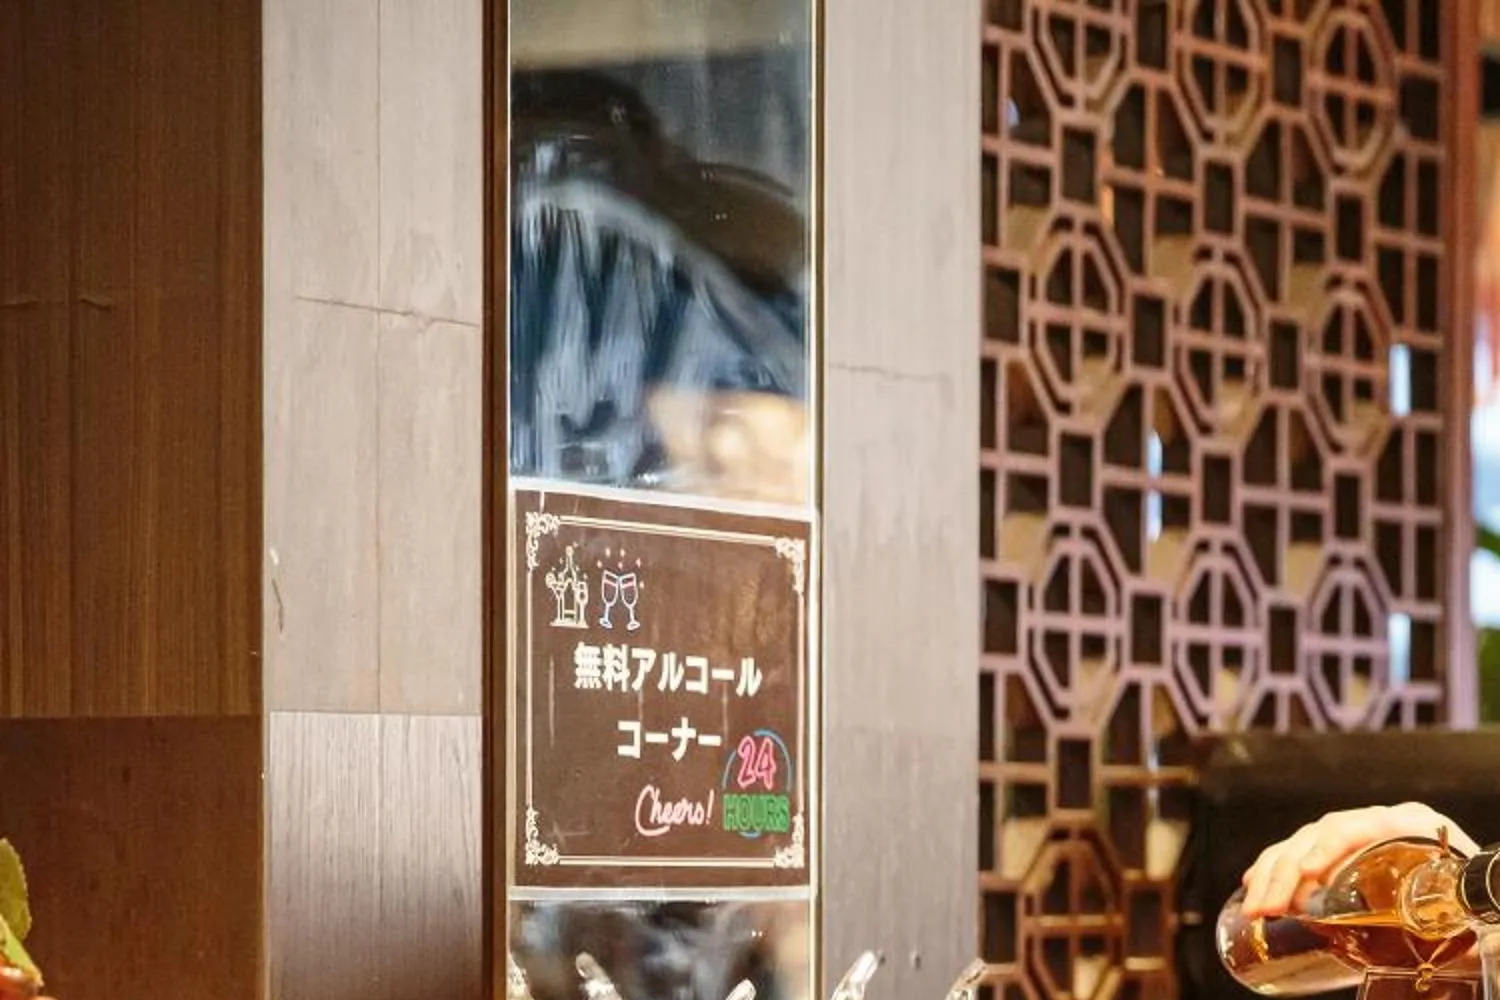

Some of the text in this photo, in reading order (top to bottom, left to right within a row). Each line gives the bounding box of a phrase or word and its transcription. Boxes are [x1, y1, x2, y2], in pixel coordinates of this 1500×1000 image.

[574, 641, 763, 696] 無料アルコール
[617, 717, 721, 761] コーナー
[738, 735, 777, 790] 24
[635, 784, 715, 837] Cheers!
[723, 793, 791, 833] HOURS
